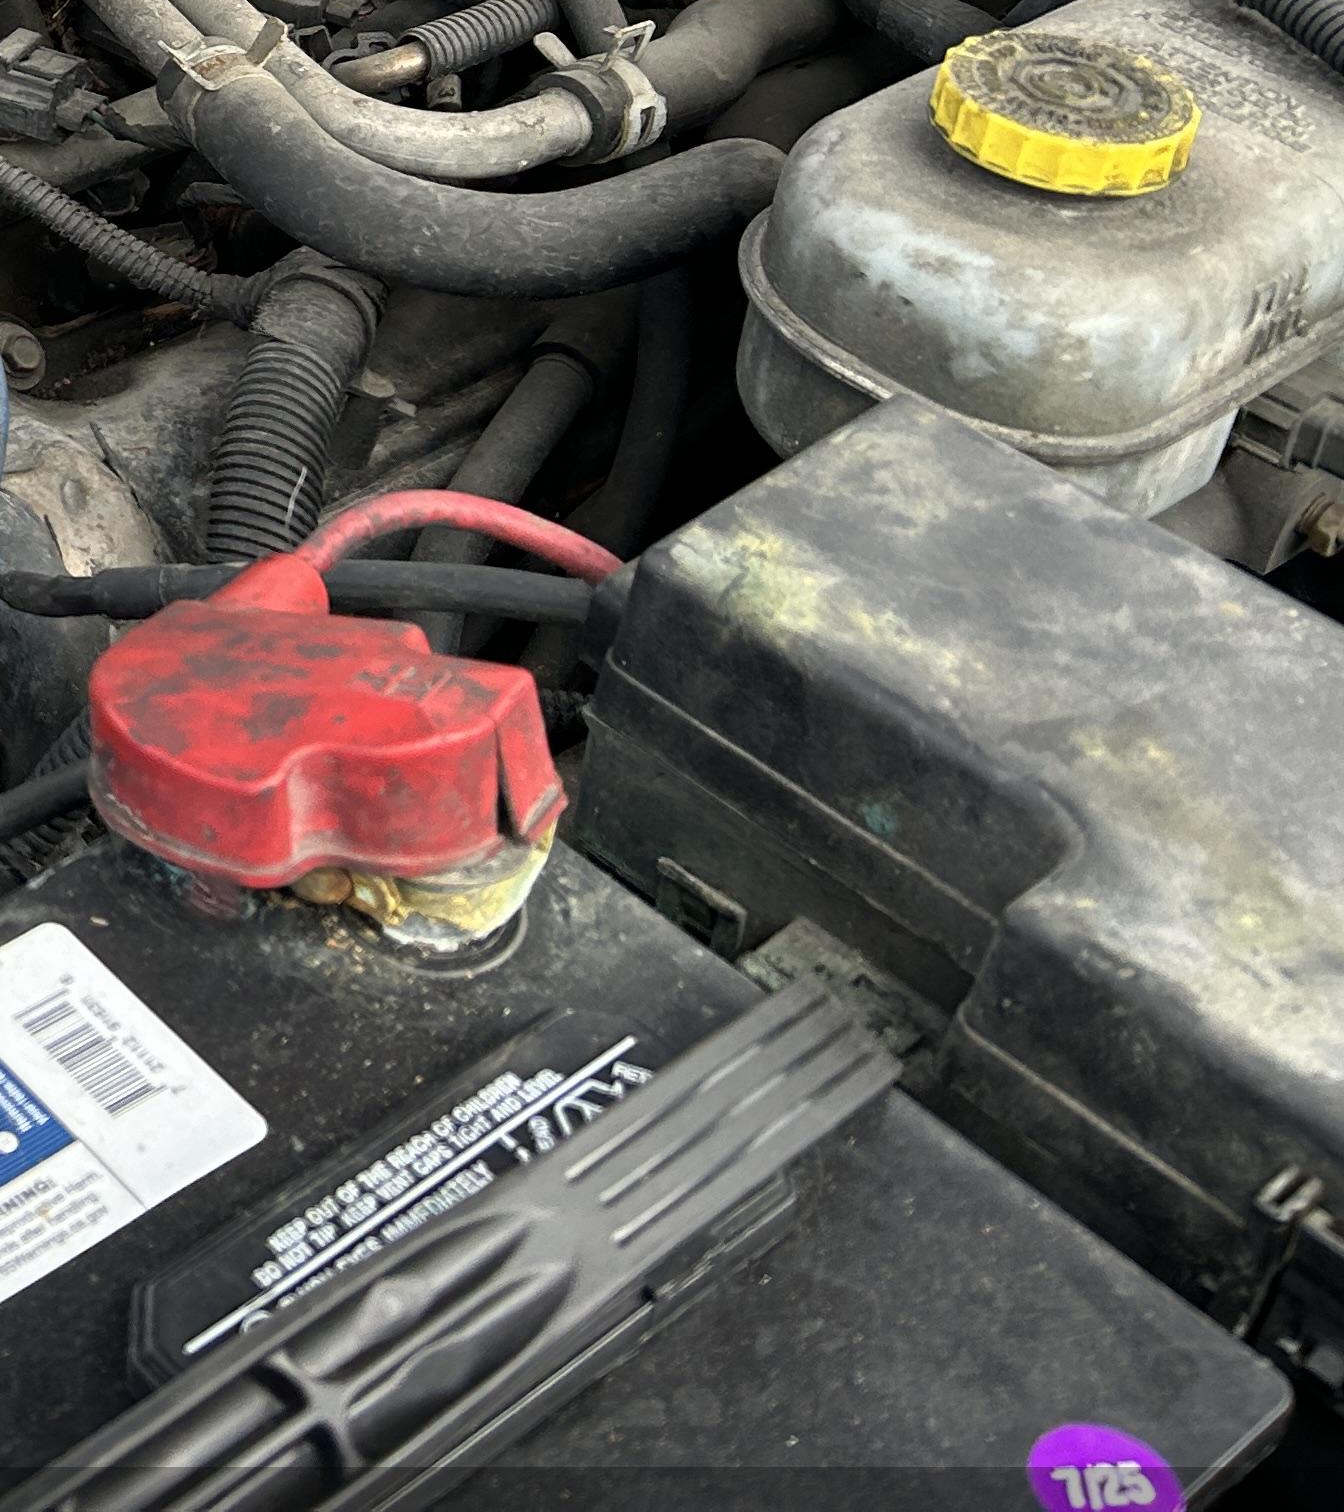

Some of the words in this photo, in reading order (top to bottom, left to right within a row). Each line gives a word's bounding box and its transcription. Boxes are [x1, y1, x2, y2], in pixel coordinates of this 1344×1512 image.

[251, 1259, 283, 1290] DO
[275, 1236, 315, 1273] NOT
[335, 1190, 382, 1231] KEEP
[372, 1166, 416, 1205] VENT
[408, 1138, 455, 1180] CAPS
[446, 1111, 493, 1153] TIGHT
[487, 1090, 524, 1124] AND
[264, 1213, 312, 1256] KEEP
[302, 1193, 341, 1229] OUT
[332, 1177, 365, 1208] OF
[354, 1156, 394, 1193] THE
[384, 1125, 438, 1172] REACH
[429, 1111, 460, 1141] OF
[449, 1066, 523, 1127] CHILDREN
